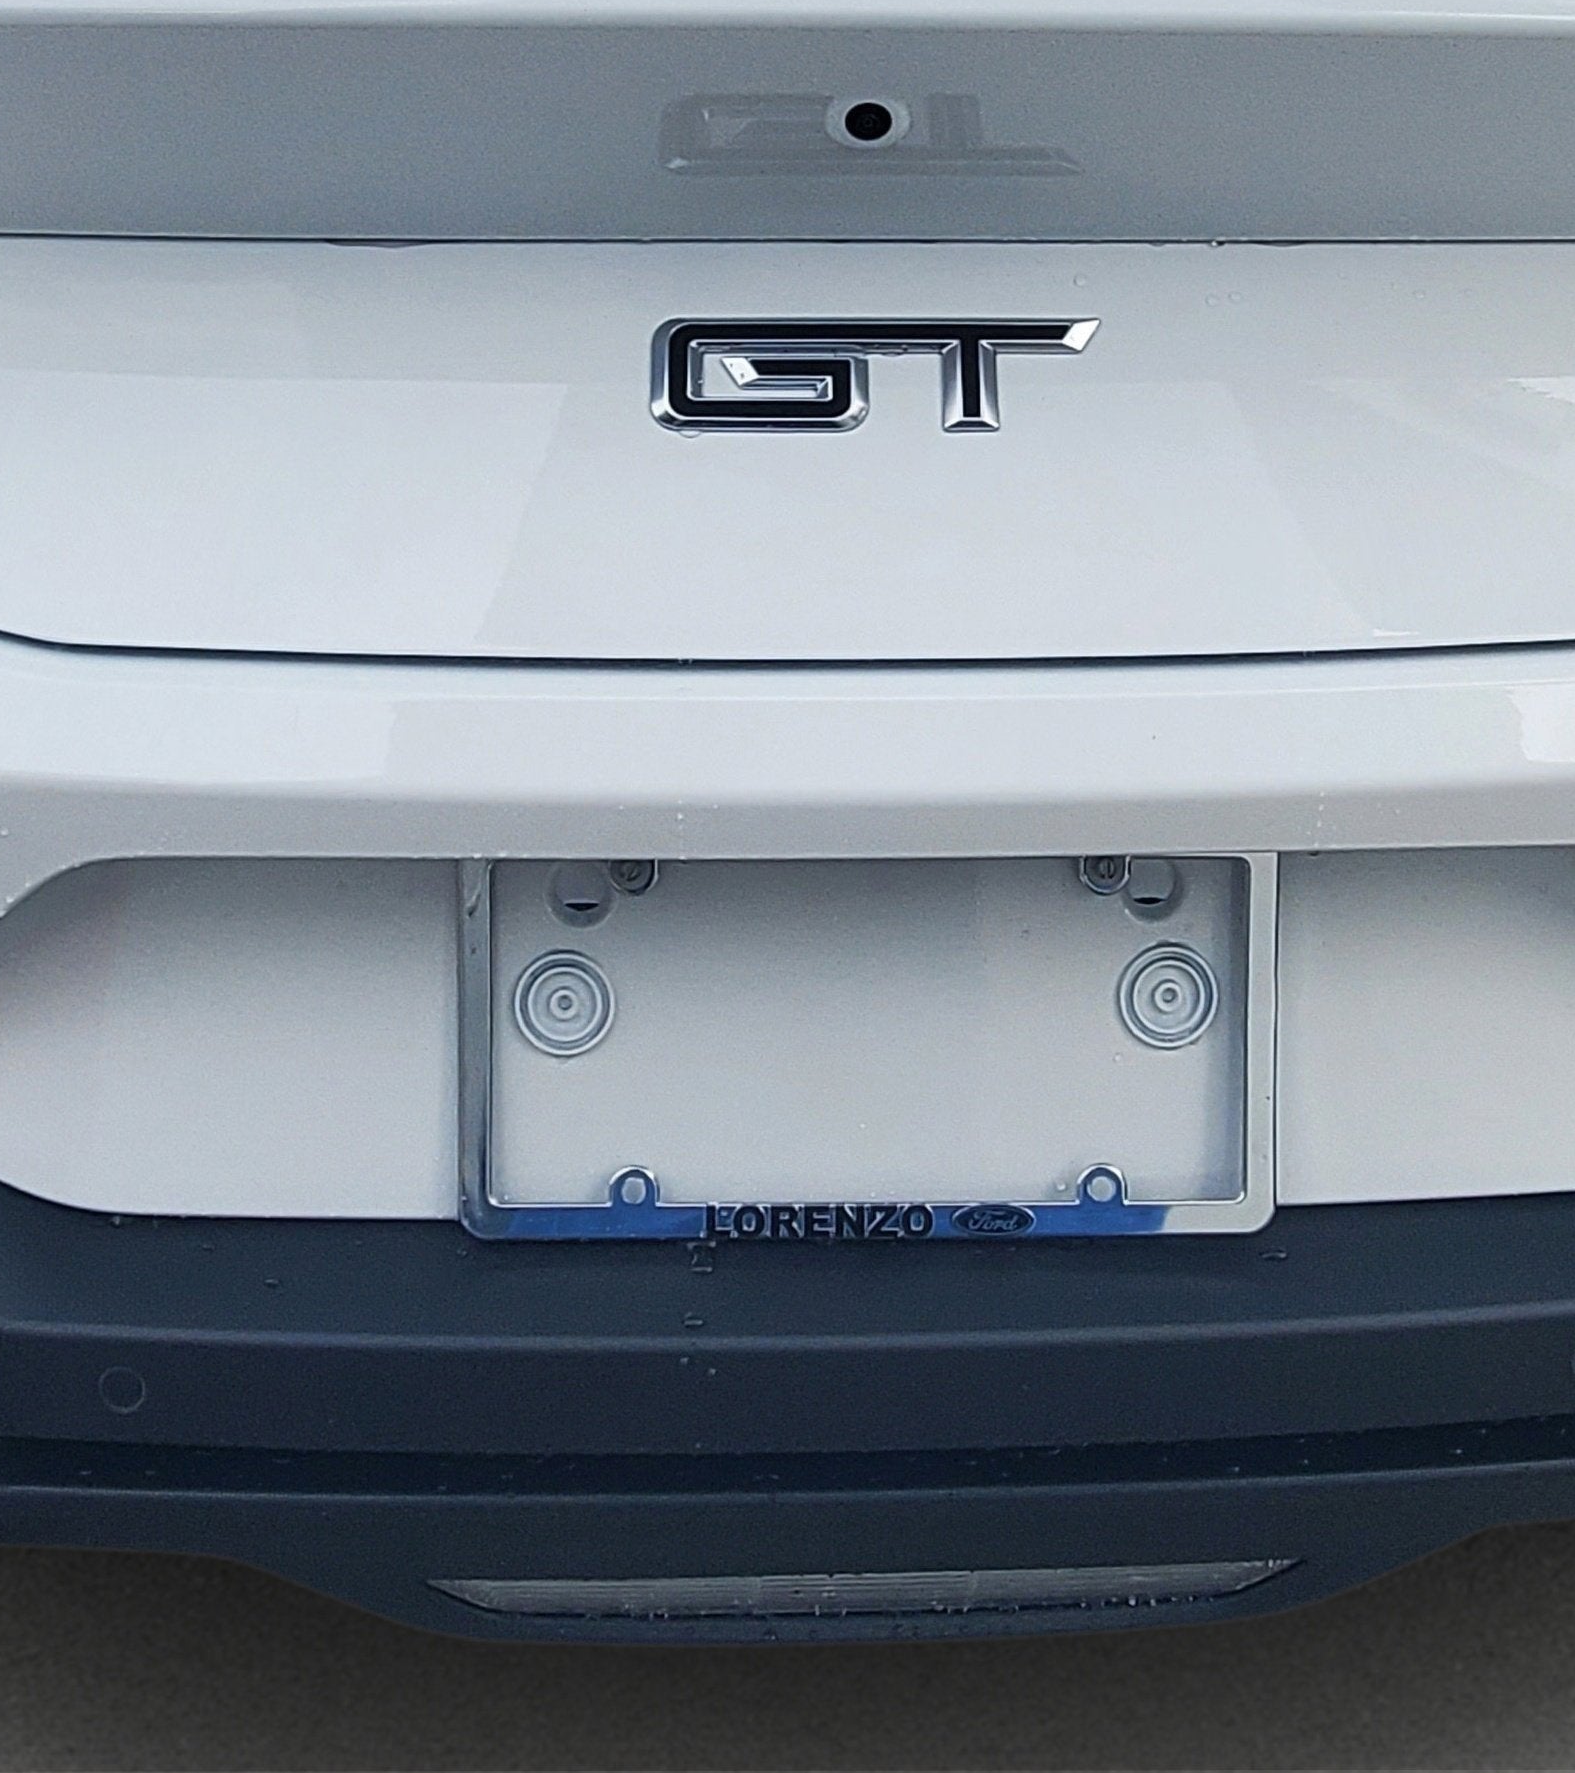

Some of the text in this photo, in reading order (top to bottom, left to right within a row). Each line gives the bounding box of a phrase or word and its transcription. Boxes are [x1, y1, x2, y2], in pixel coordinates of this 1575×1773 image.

[650, 317, 1101, 432] GT
[707, 1204, 1020, 1238] LORENZO Ford
